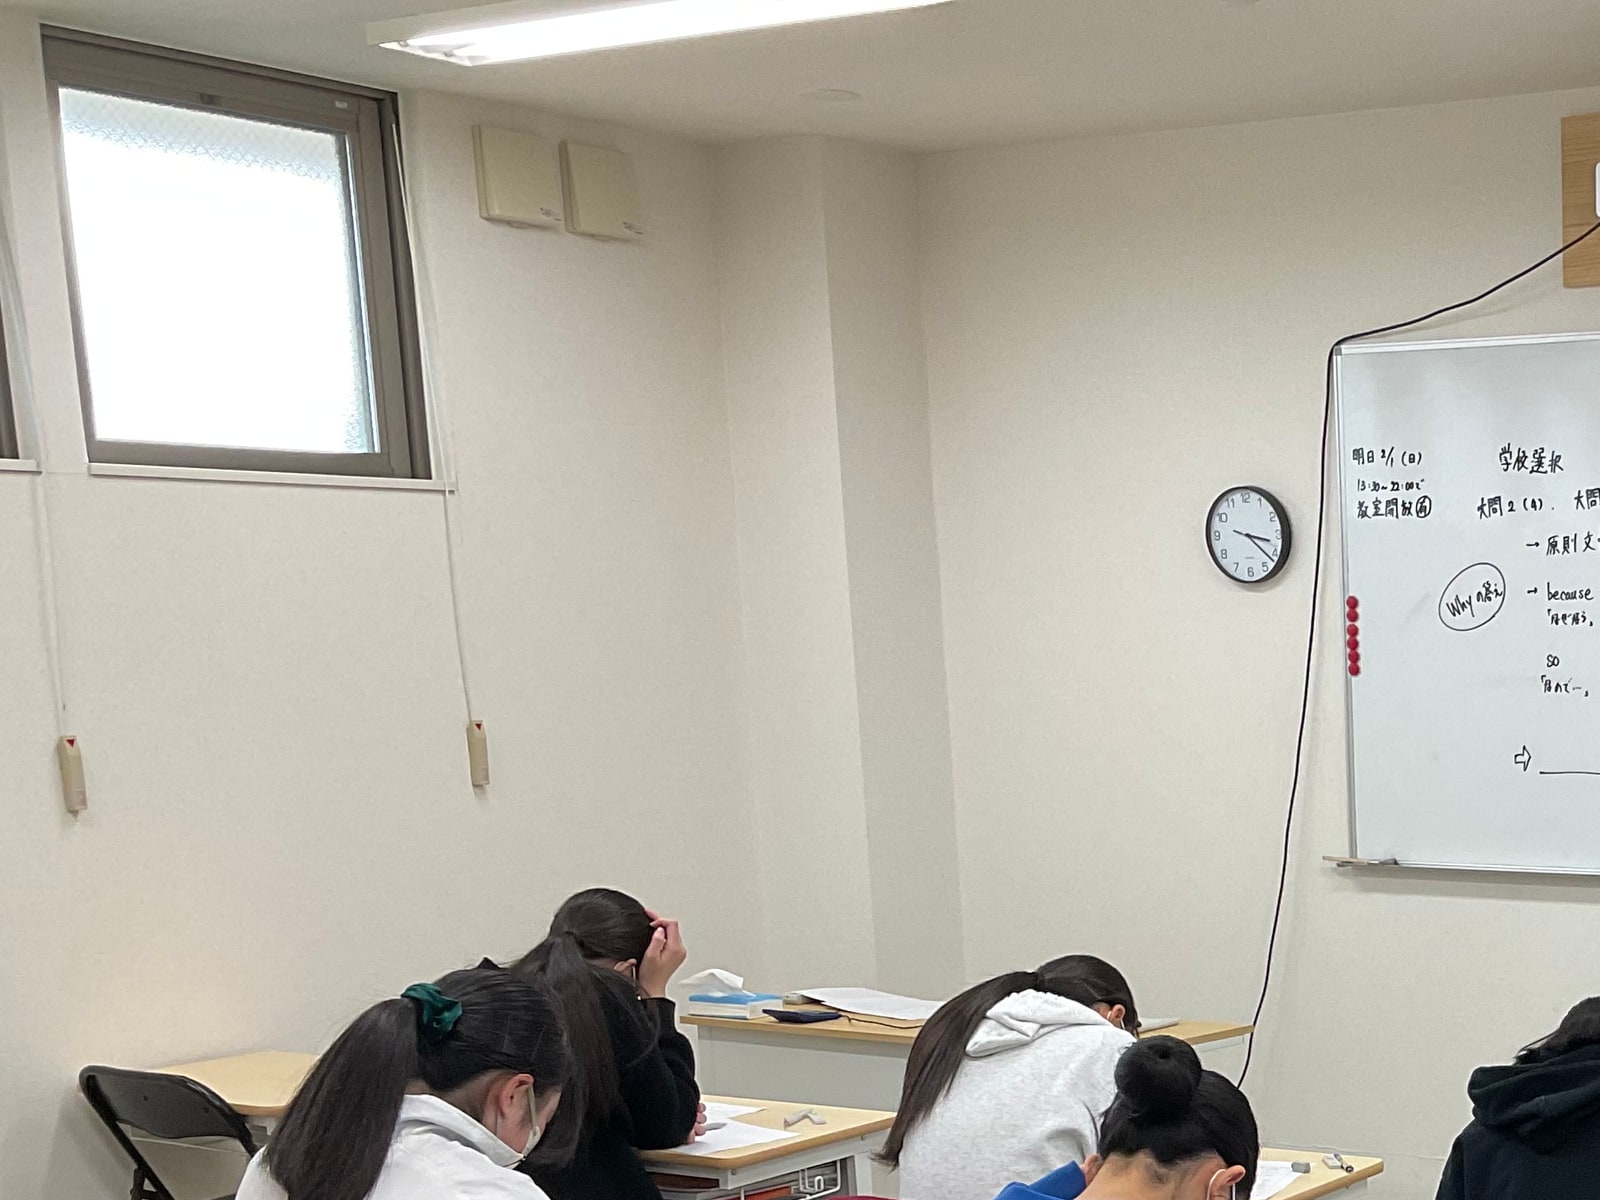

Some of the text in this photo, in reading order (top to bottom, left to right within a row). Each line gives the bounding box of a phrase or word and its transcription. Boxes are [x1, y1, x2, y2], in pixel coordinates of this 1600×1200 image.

[1225, 497, 1235, 508] 11
[1240, 492, 1251, 504] 12
[1257, 497, 1263, 508] 1
[1217, 512, 1228, 523] 10
[1269, 512, 1276, 522] 2
[1214, 530, 1221, 541] 9
[1220, 549, 1228, 559] 8
[1272, 548, 1278, 557] 4
[1233, 562, 1239, 572] 7
[1247, 566, 1255, 577] 6
[1262, 562, 1269, 572] 5
[1546, 581, 1594, 601] because
